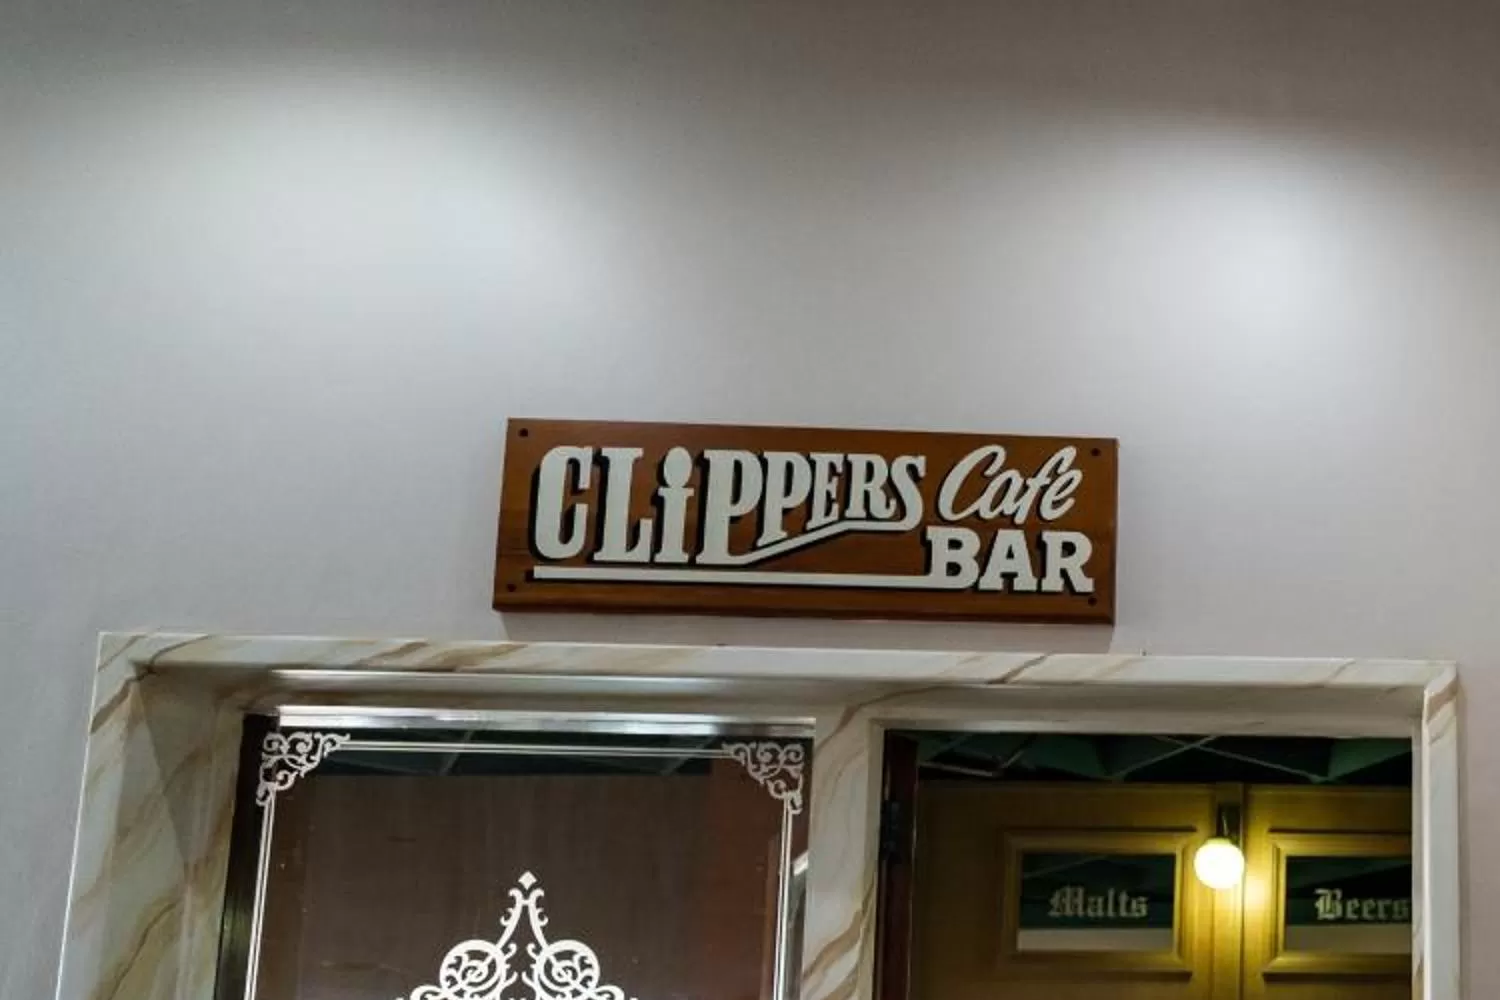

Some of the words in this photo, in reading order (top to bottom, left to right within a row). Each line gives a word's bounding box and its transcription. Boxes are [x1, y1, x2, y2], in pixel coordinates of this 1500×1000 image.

[925, 527, 1096, 593] BAR
[1047, 885, 1149, 918] Malts
[1314, 888, 1410, 920] Beers
